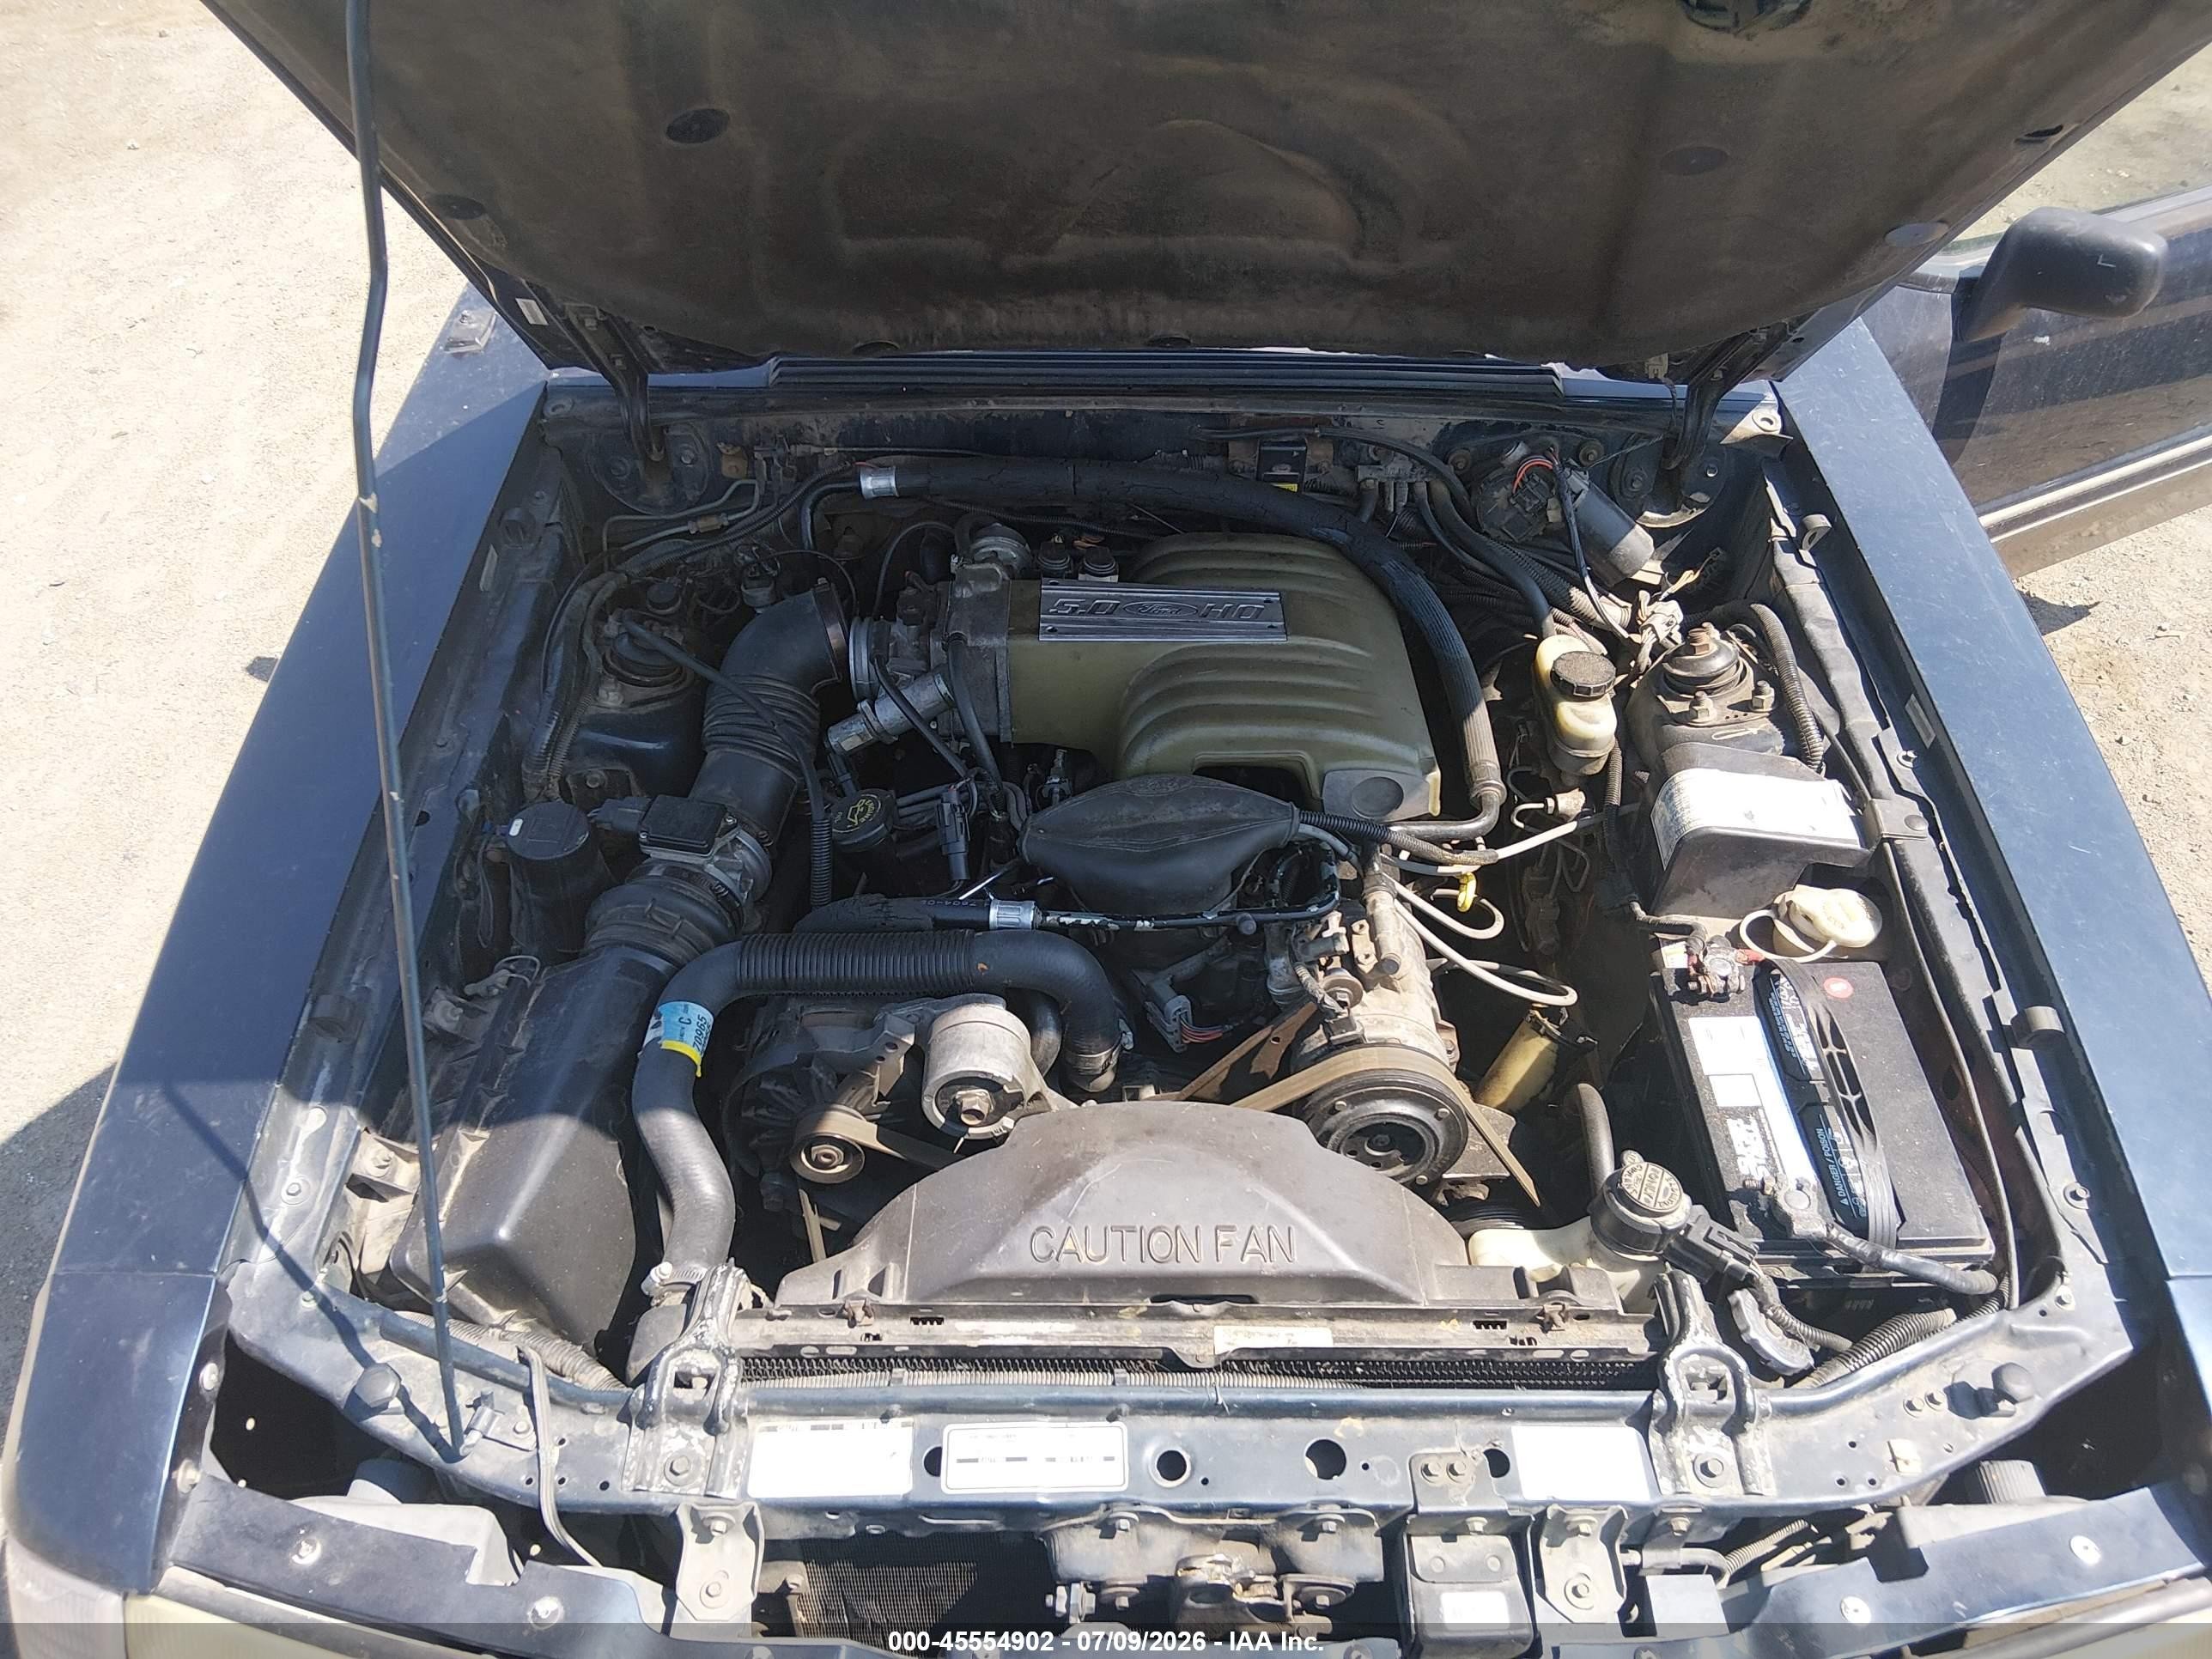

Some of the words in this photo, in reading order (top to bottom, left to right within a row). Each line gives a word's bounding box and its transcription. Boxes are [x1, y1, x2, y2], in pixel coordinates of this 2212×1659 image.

[1050, 598, 1120, 617] 5.0
[1199, 603, 1265, 620] HO
[692, 1014, 708, 1052] 70965
[1816, 1127, 1832, 1157] POISON
[1829, 1164, 1847, 1197] DANGER
[1030, 1225, 1202, 1263] CAUTION
[1215, 1225, 1296, 1263] FAN
